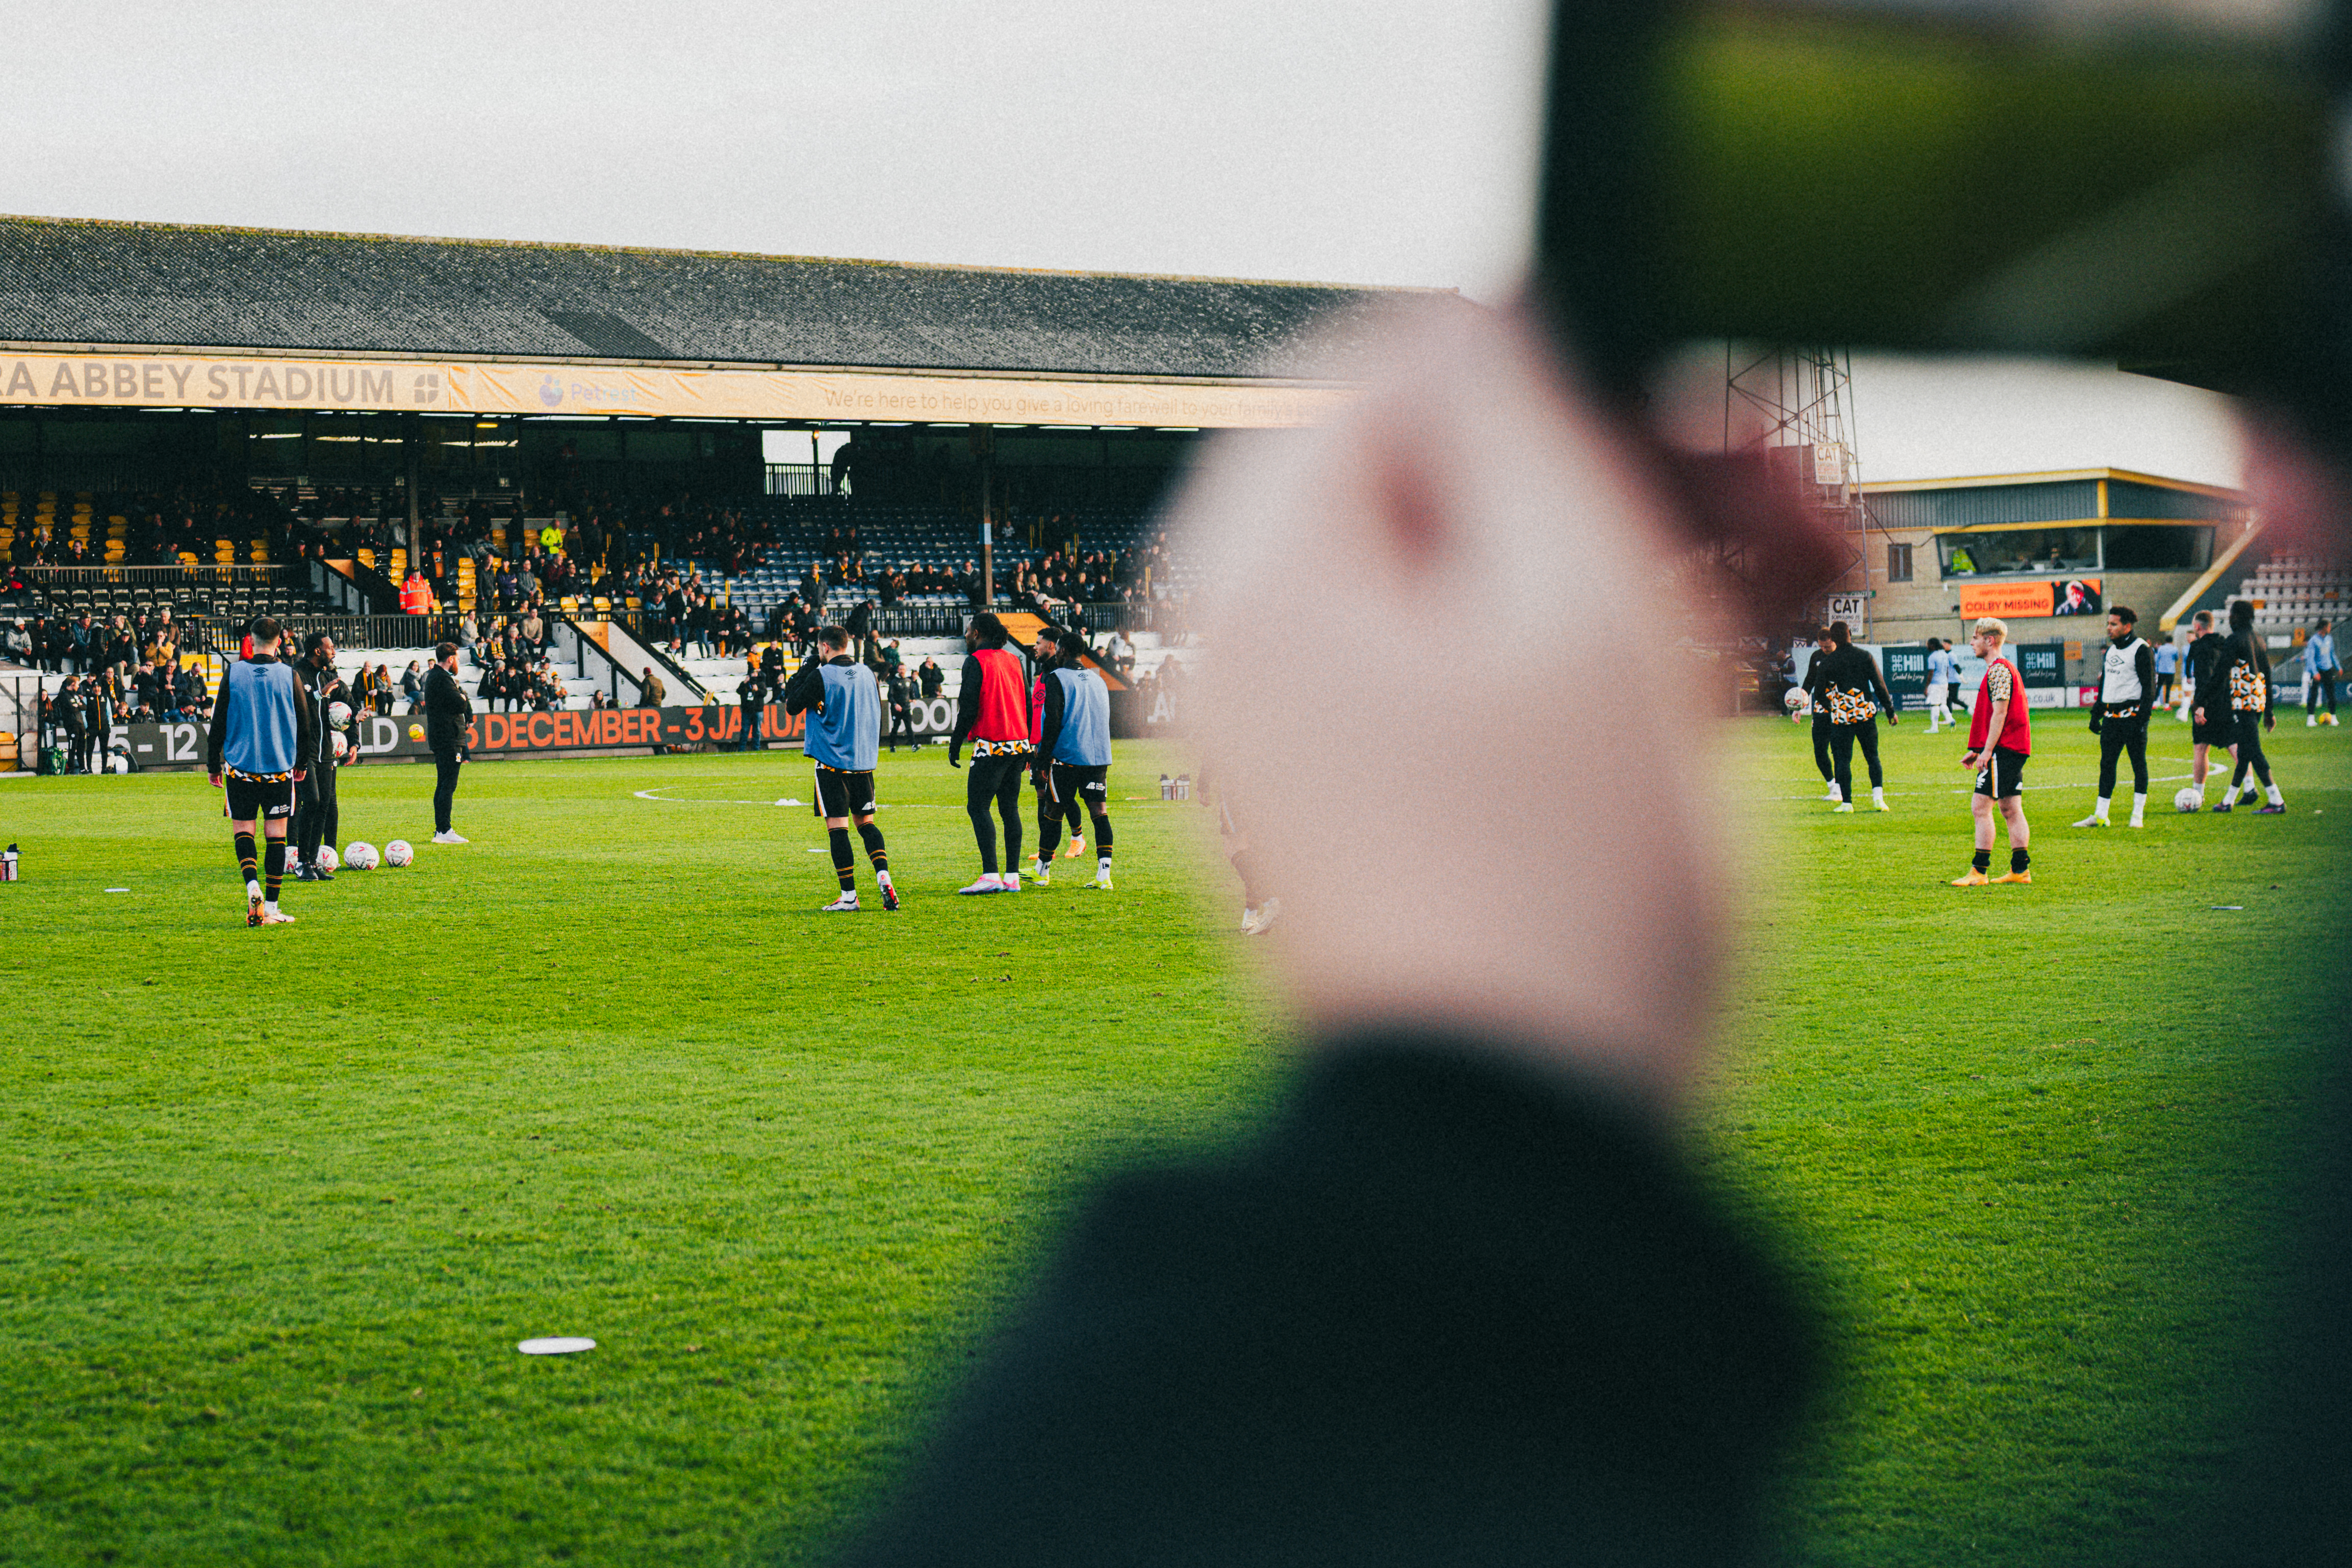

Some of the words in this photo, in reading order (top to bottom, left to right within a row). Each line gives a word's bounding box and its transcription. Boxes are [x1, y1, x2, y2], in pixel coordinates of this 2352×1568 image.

[0, 362, 39, 396] A
[49, 362, 194, 399] ABBEY
[207, 365, 394, 404] STADIUM
[571, 382, 637, 402] Petrest
[825, 389, 874, 407] We're
[879, 391, 916, 409] here
[921, 393, 938, 409] to
[943, 392, 978, 412] help
[982, 397, 1011, 415] you
[1016, 394, 1049, 416] give
[1054, 399, 1062, 412] a
[1066, 394, 1113, 417] loving
[1118, 397, 1178, 414] farewell
[1183, 399, 1197, 415] to
[1817, 447, 1837, 461] CAT
[1833, 598, 1860, 614] CAT
[1965, 602, 2002, 612] COLBY
[2004, 598, 2049, 610] MISSING
[1904, 654, 1924, 672] Hill
[2036, 651, 2056, 669] Hill
[356, 717, 399, 754] LD
[484, 709, 661, 749] DECEMBER
[685, 707, 705, 741] 3
[708, 705, 807, 740] JANUA
[159, 723, 198, 761] 12
